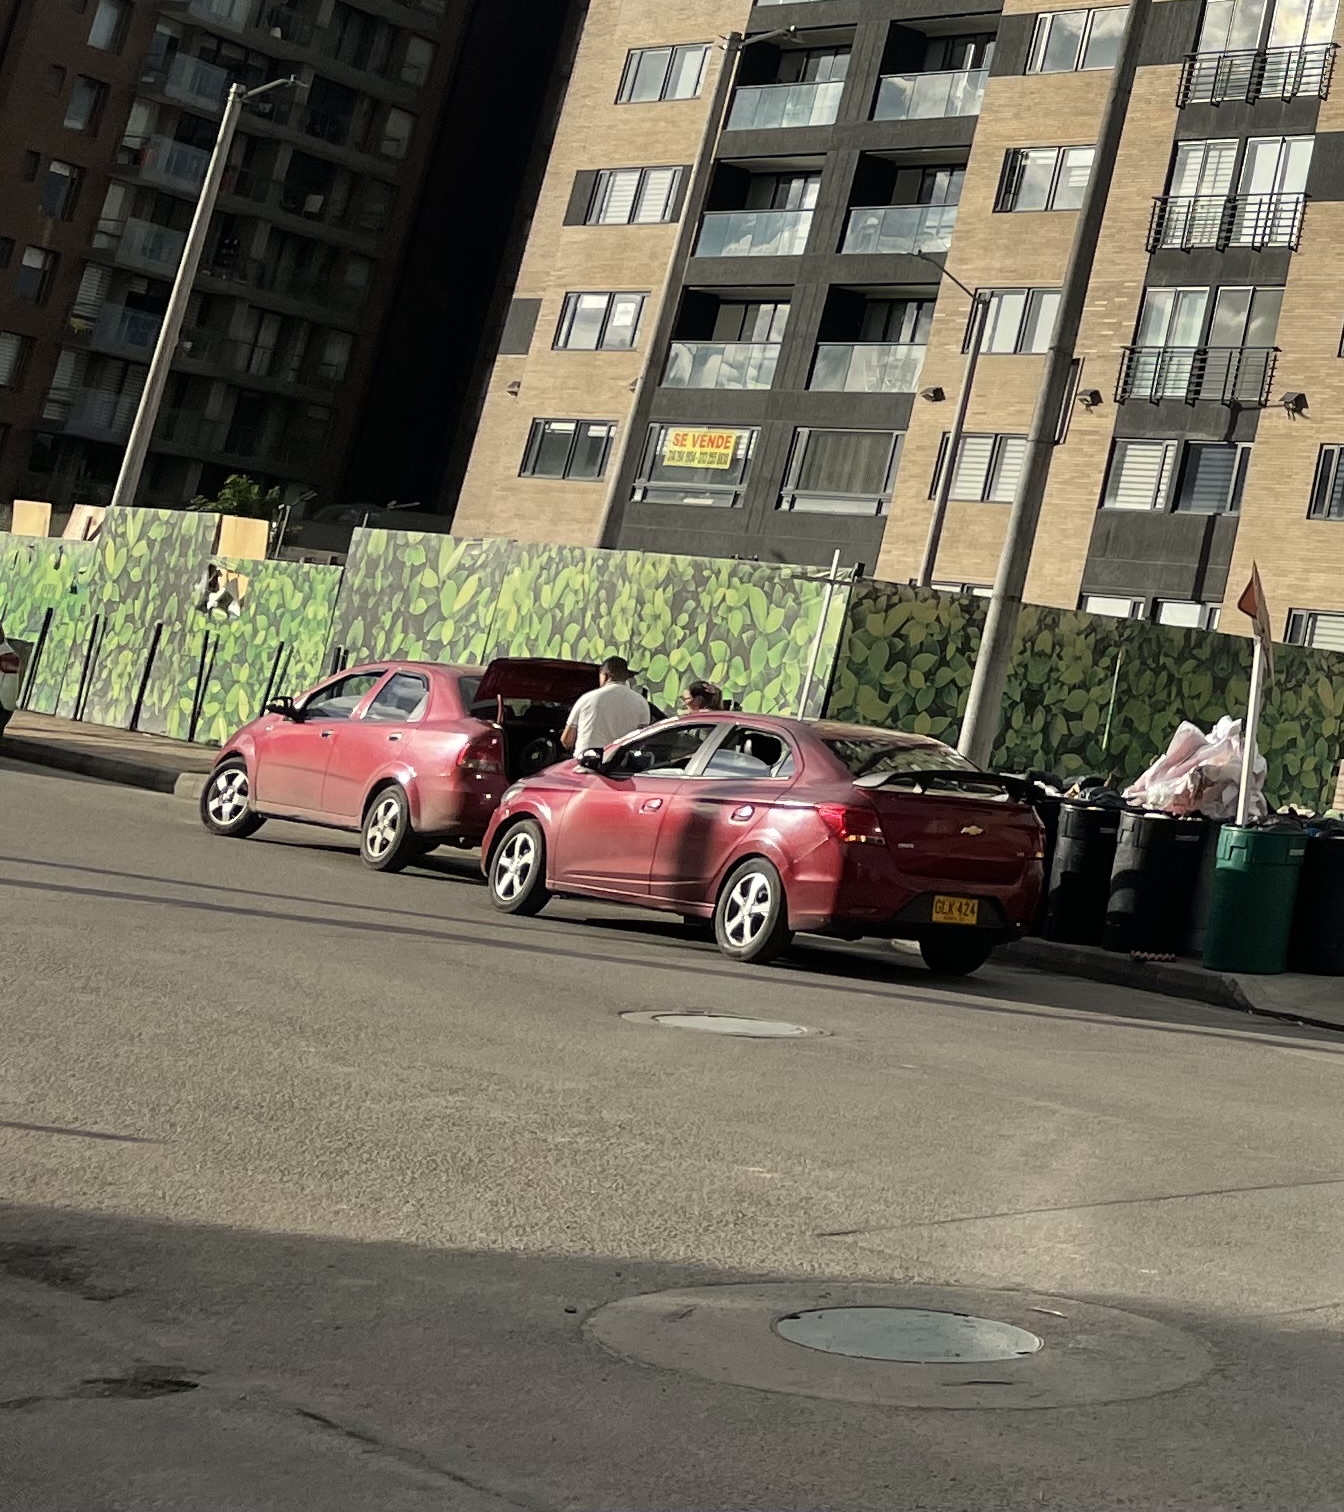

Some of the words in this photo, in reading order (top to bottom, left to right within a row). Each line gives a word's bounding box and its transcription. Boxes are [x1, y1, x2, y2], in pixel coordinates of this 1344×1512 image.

[672, 432, 689, 448] SE
[692, 433, 733, 450] VENDE
[957, 902, 975, 916] 424
